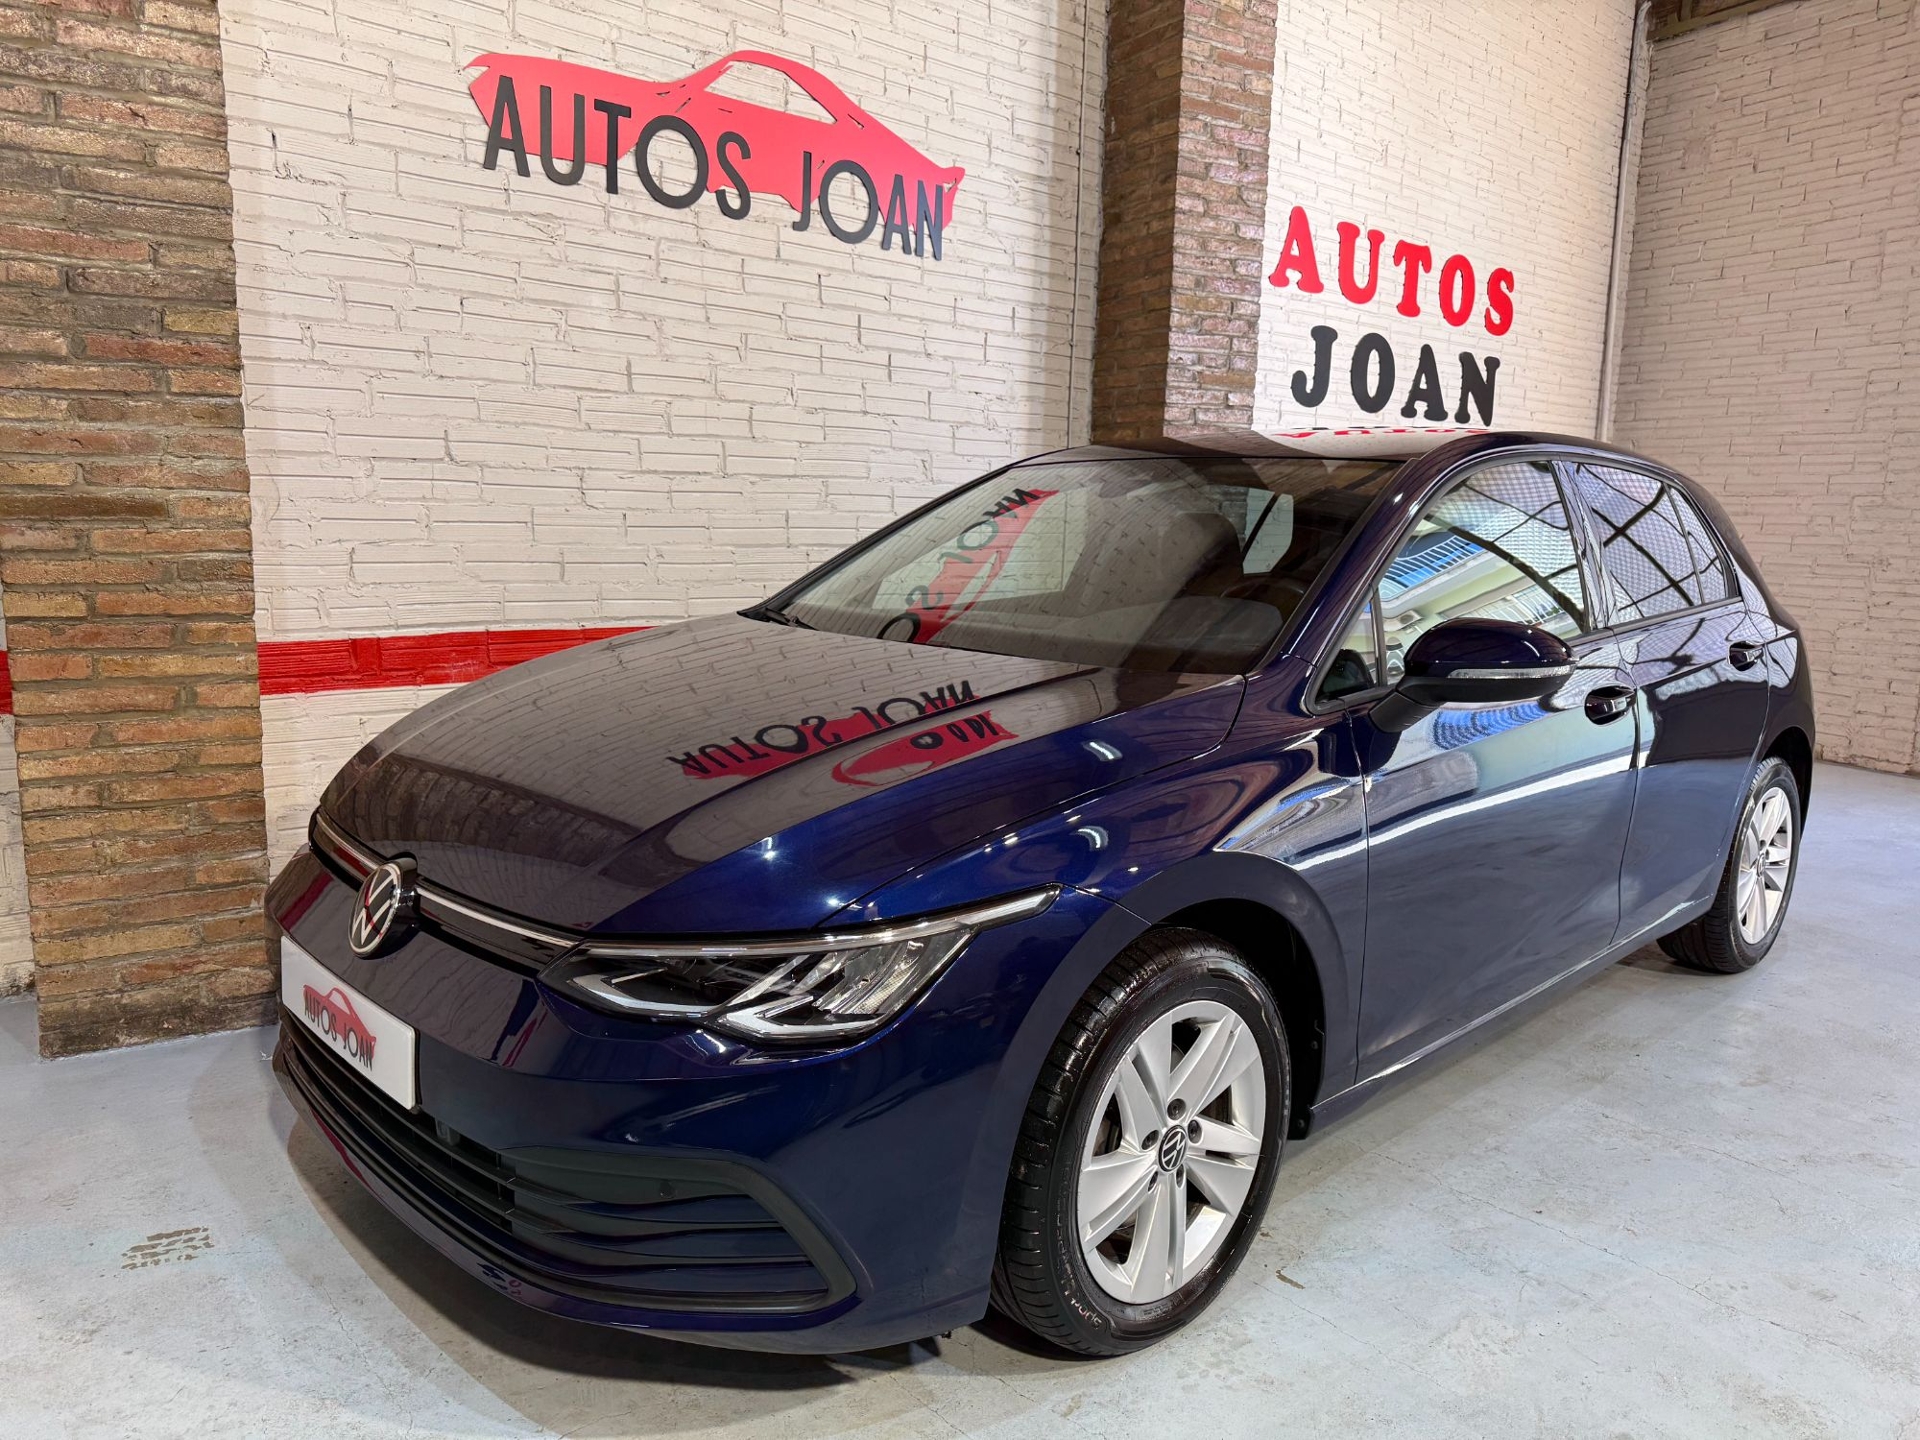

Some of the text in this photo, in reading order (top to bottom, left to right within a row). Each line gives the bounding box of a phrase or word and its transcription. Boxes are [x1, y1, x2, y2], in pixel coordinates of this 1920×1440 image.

[483, 75, 944, 261] AUTOS JOAN
[1268, 206, 1515, 336] AUTOS
[1290, 325, 1500, 427] JOAN
[303, 990, 374, 1071] AUTOS JOAN
